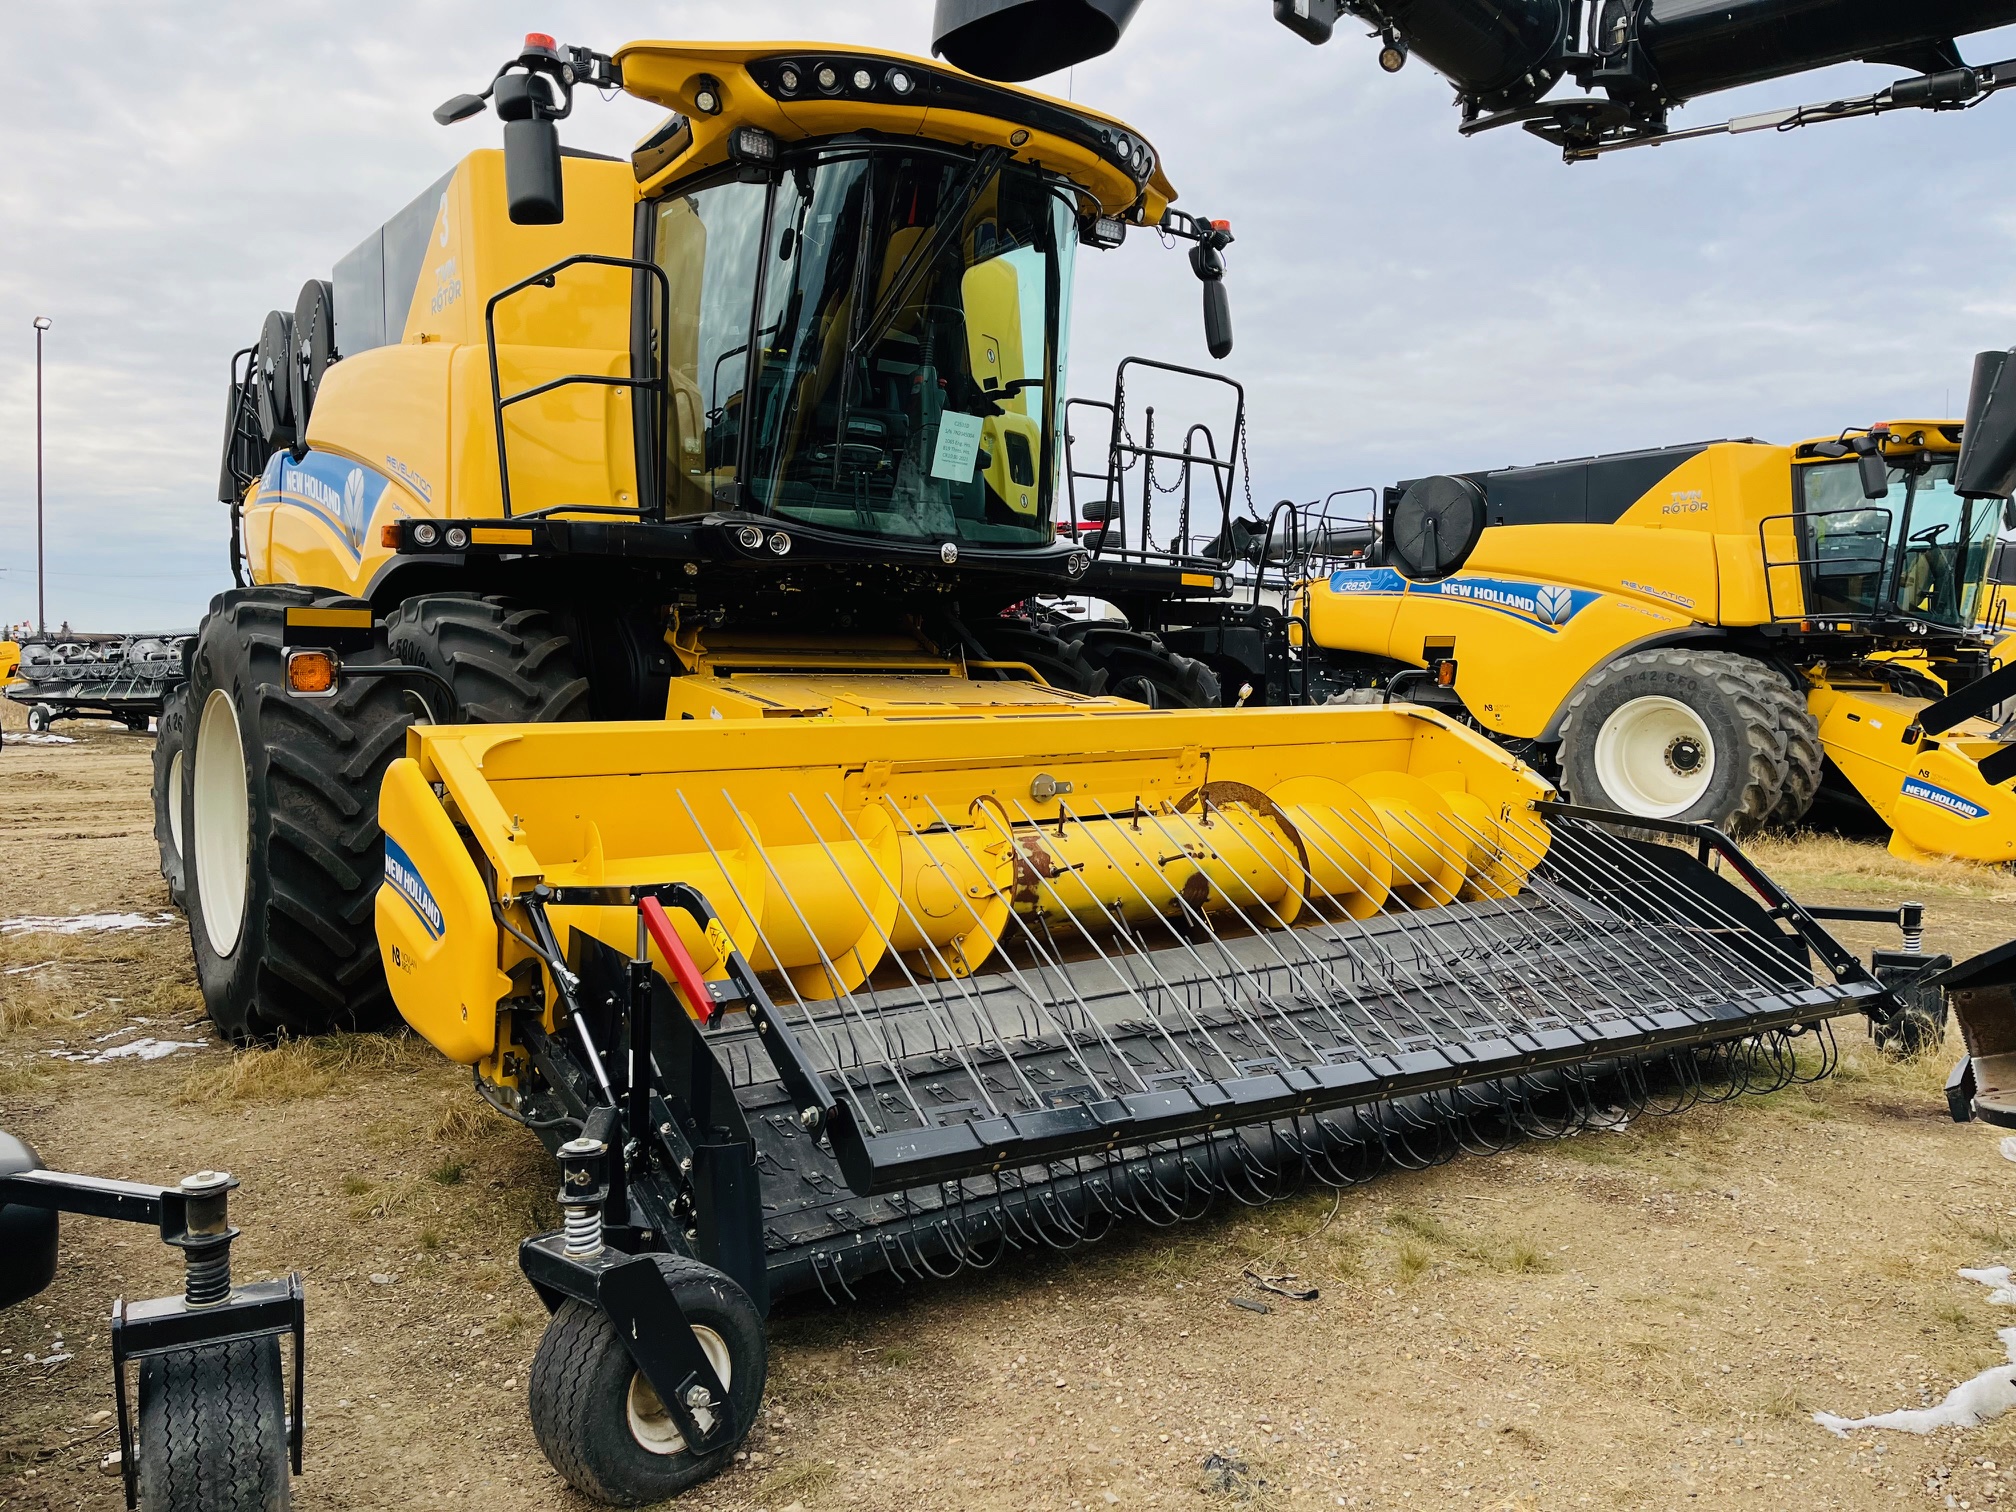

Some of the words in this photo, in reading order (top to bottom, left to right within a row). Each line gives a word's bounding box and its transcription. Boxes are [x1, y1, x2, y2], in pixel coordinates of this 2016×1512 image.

[440, 192, 449, 248] 3
[435, 256, 457, 287] TWIN
[431, 279, 462, 316] ROTOR
[386, 455, 433, 496] REVELATION
[286, 470, 303, 495] NEW
[304, 474, 341, 517] HOLLAND
[1662, 501, 1709, 515] ROTOR
[1671, 489, 1702, 501] TWIN
[1340, 581, 1372, 591] CR8.90
[1441, 582, 1473, 597] NEW
[1473, 586, 1535, 612] HOLLAND
[1621, 579, 1696, 606] REVELATION
[1617, 602, 1672, 622] OPTI-CLEAN
[1639, 671, 1658, 682] 42
[173, 712, 184, 734] 26
[1905, 783, 1930, 799] NEW
[1930, 791, 1978, 817] HOLLAND
[385, 853, 403, 884] NEW
[403, 870, 440, 929] HOLLAND
